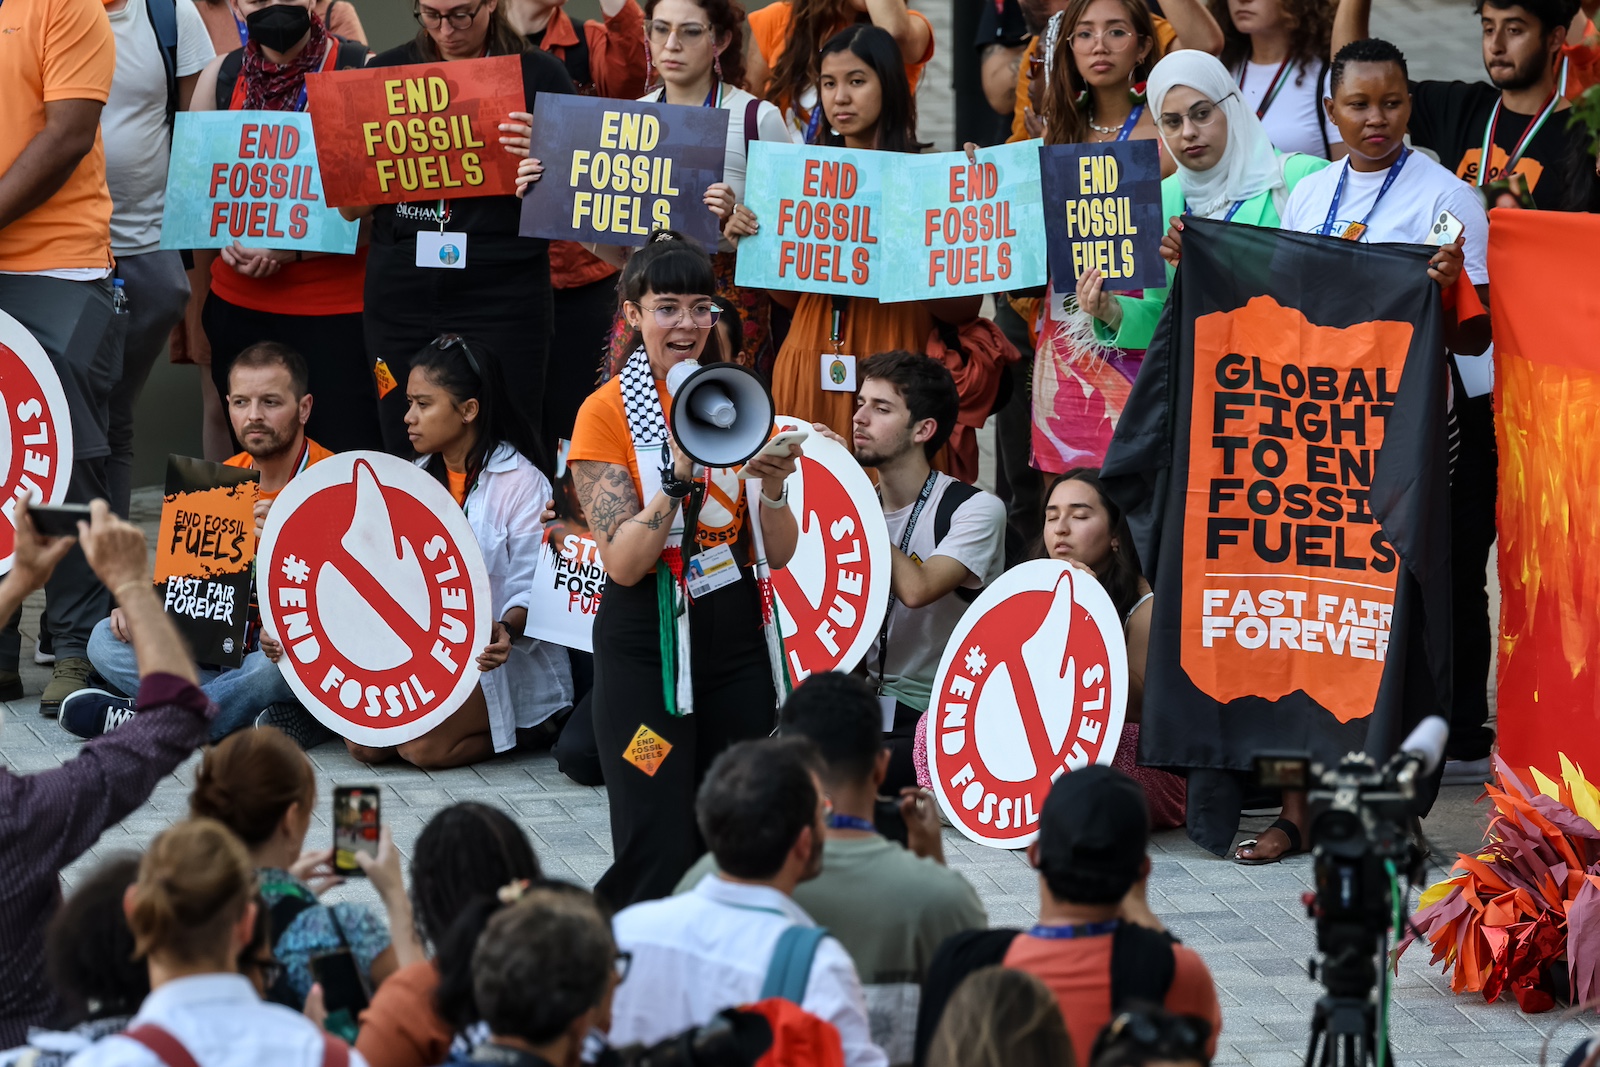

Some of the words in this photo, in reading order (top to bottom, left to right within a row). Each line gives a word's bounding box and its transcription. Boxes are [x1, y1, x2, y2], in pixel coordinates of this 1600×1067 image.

[384, 76, 450, 116] END
[238, 123, 300, 159] END
[362, 114, 485, 157] FOSSIL
[600, 111, 660, 152] END
[209, 162, 319, 201] FOSSIL
[375, 152, 485, 193] FUELS
[569, 149, 680, 197] FOSSIL
[803, 159, 858, 199] END
[949, 162, 999, 203] END
[1078, 154, 1119, 195] END
[209, 201, 309, 239] FUELS
[571, 191, 671, 236] FUELS
[777, 198, 878, 244] FOSSIL
[924, 200, 1017, 247] FOSSIL
[1065, 196, 1138, 239] FOSSIL
[778, 240, 870, 286] FUELS
[928, 242, 1012, 287] FUELS
[1071, 239, 1135, 281] FUELS
[1215, 353, 1398, 403] GLOBAL
[1212, 435, 1288, 479] TO
[1306, 444, 1381, 487] EN
[1208, 478, 1382, 525] FOSSI
[175, 510, 201, 528] END
[205, 515, 247, 535] FOSSIL
[171, 525, 245, 564] FUELS
[1206, 518, 1397, 574] FUELS
[167, 575, 202, 597] FAST
[206, 582, 235, 605] FAIR
[815, 515, 863, 658] FUELS
[1202, 589, 1307, 618] FAST
[164, 592, 234, 626] FOREVER
[278, 553, 321, 664] #END
[319, 664, 436, 718] FOSSIL
[423, 534, 468, 675] FUELS
[631, 743, 663, 755] FOSSIL
[634, 750, 663, 762] FUELS
[636, 737, 655, 747] END
[950, 762, 1040, 830] FOSSIL
